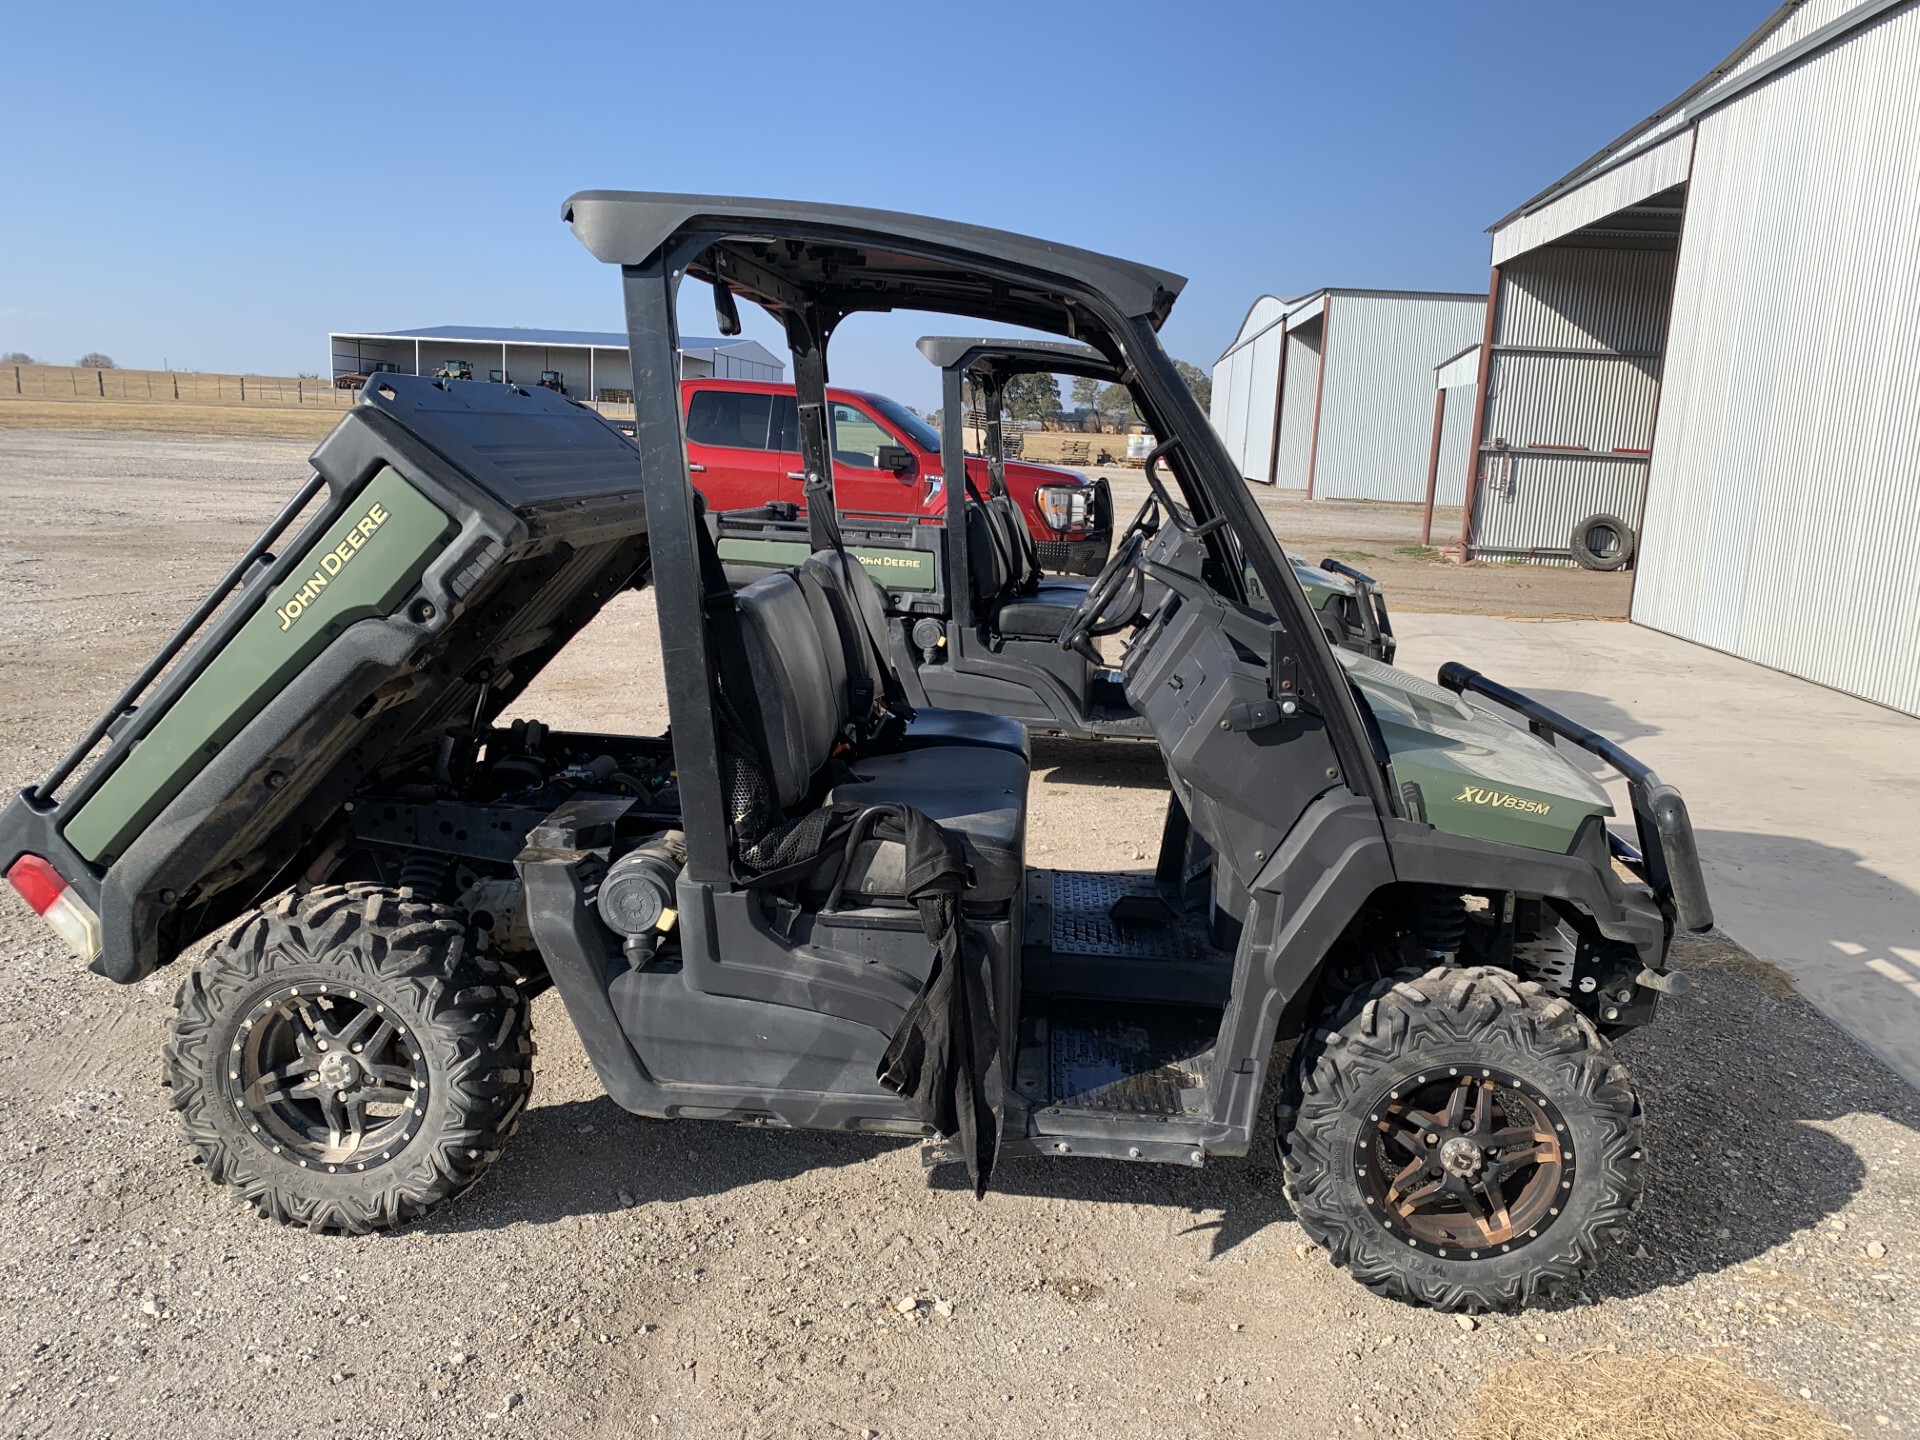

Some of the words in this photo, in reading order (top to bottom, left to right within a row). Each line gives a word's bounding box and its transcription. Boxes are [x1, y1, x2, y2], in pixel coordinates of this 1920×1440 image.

[275, 571, 328, 632] JOHN
[320, 502, 389, 577] DEERE
[856, 554, 882, 566] OHN
[883, 557, 921, 568] DEERE
[1455, 785, 1552, 816] XUV835M
